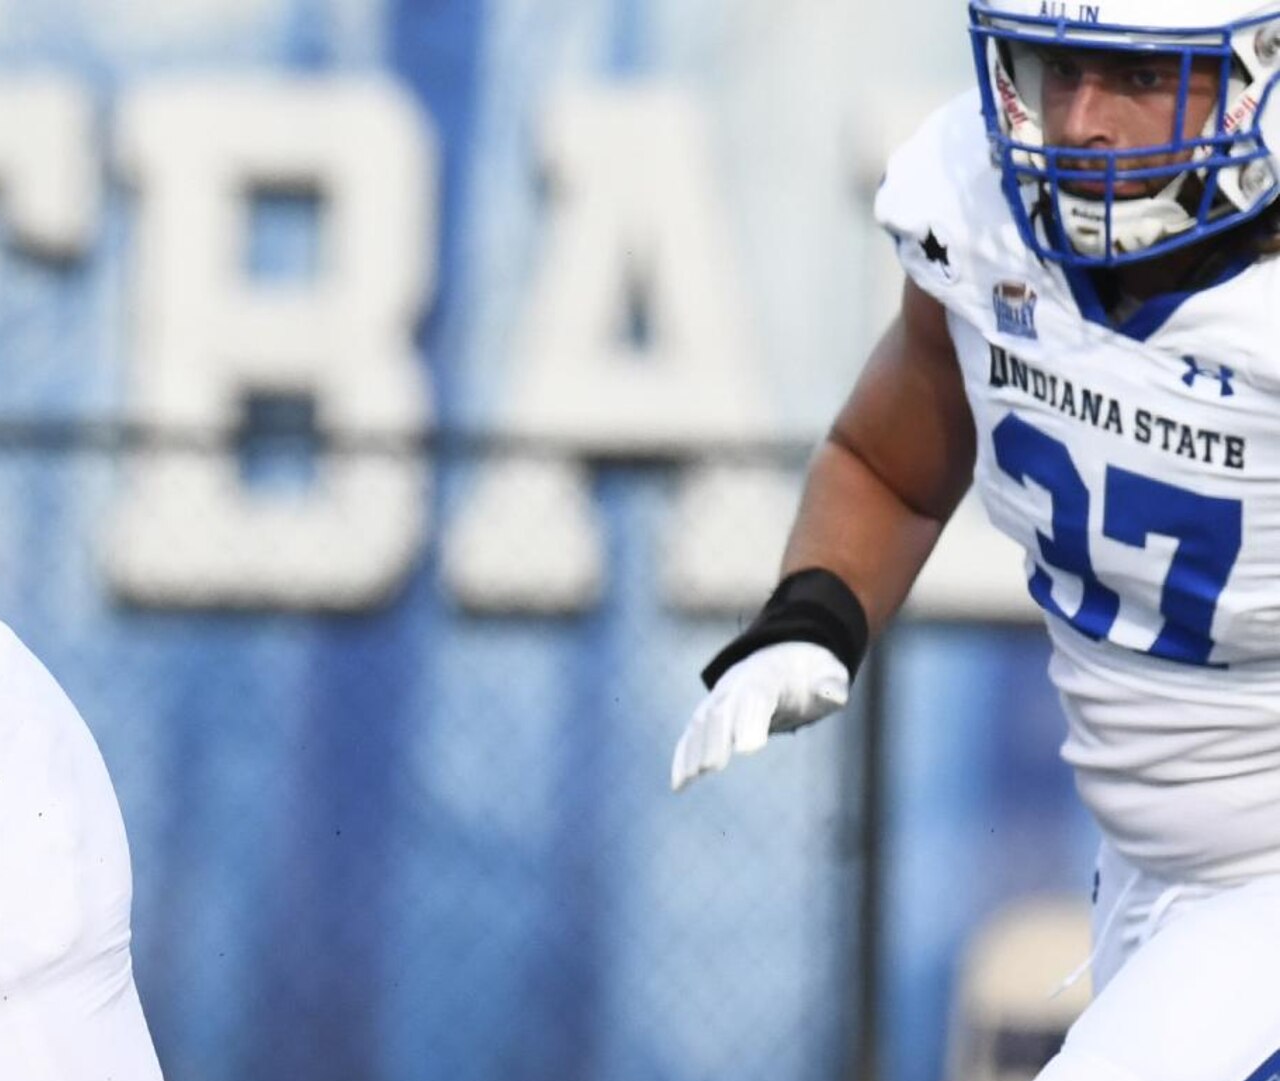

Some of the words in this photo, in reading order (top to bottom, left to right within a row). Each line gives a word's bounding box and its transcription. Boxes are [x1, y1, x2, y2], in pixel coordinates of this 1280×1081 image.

[989, 342, 1124, 436] INDIANA
[1134, 408, 1247, 470] STATE
[992, 411, 1243, 669] 37
